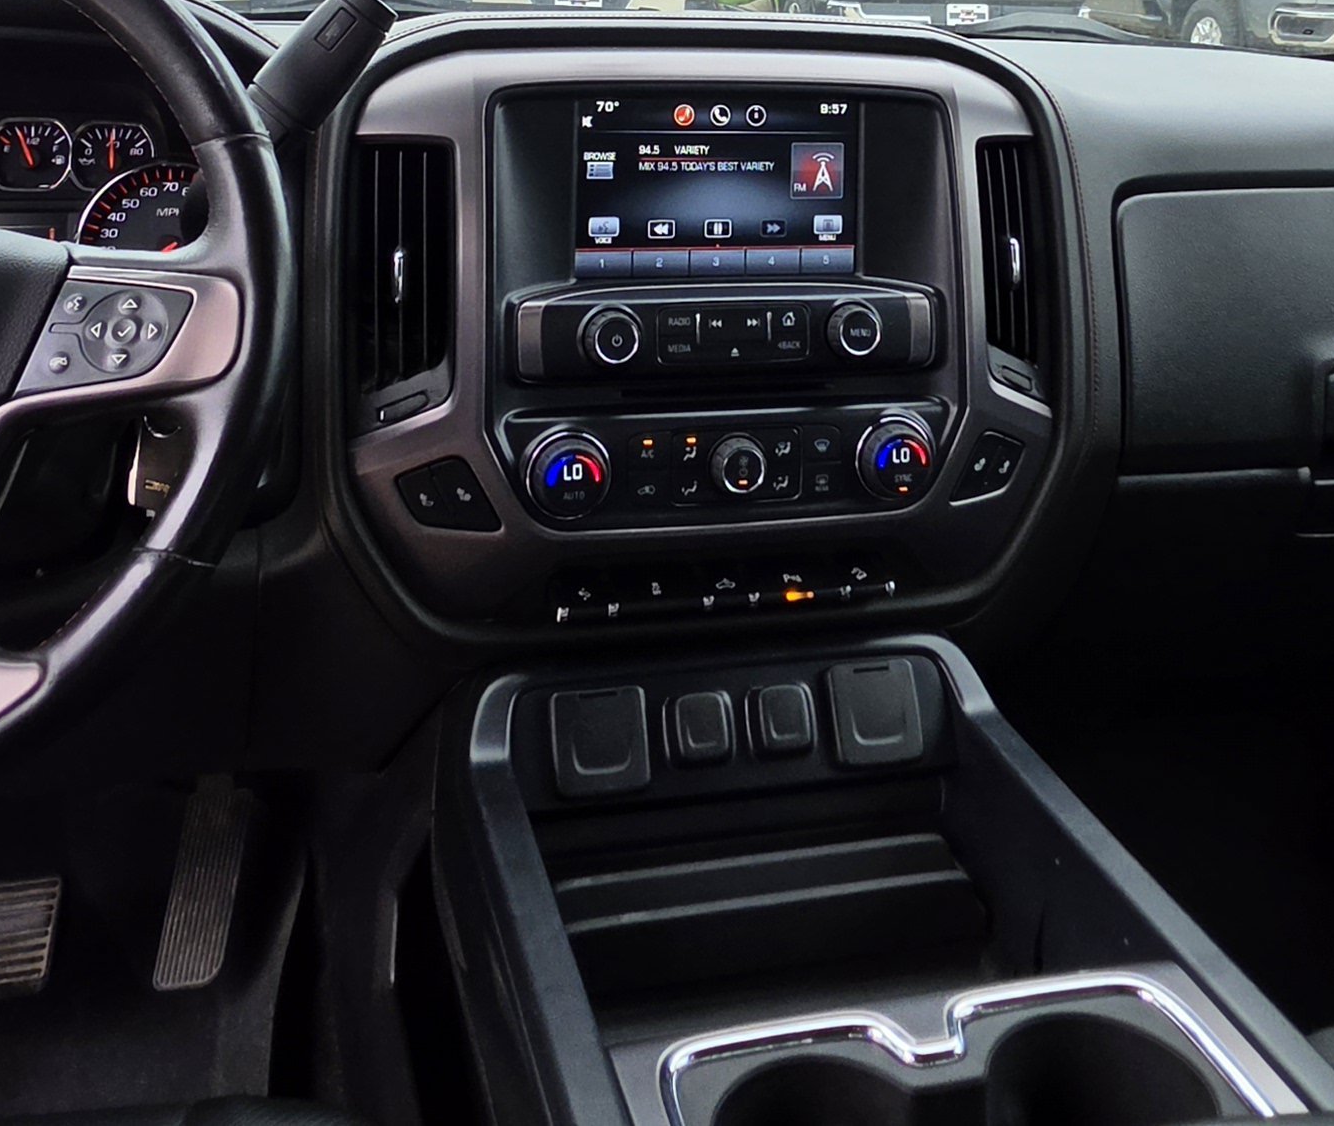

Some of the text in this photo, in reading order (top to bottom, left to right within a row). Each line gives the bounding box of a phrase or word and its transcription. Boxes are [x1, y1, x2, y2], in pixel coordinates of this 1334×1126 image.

[820, 103, 848, 115] 8:57
[52, 145, 60, 153] F
[84, 147, 144, 156] 0 80
[638, 144, 710, 156] 94.5 VARIETY
[583, 151, 617, 162] BROWSE
[638, 161, 775, 172] MIX 94.5 TODAY'S BEST VARIETY
[139, 187, 158, 198] 60
[162, 182, 179, 192] 70
[793, 183, 807, 193] FM
[121, 199, 140, 209] 50
[107, 212, 126, 222] 40
[99, 228, 119, 239] 30
[598, 258, 606, 269] 1
[655, 257, 664, 268] 2
[711, 257, 721, 267] 3
[767, 256, 776, 267] 4
[822, 255, 830, 266] 5
[667, 317, 692, 329] RADIO
[849, 327, 872, 339] MENU
[667, 343, 693, 355] MEDIA
[640, 448, 655, 460] A/C
[891, 447, 911, 464] LO
[563, 463, 584, 482] LO
[893, 473, 913, 485] SYNC
[562, 490, 586, 501] AUTO
